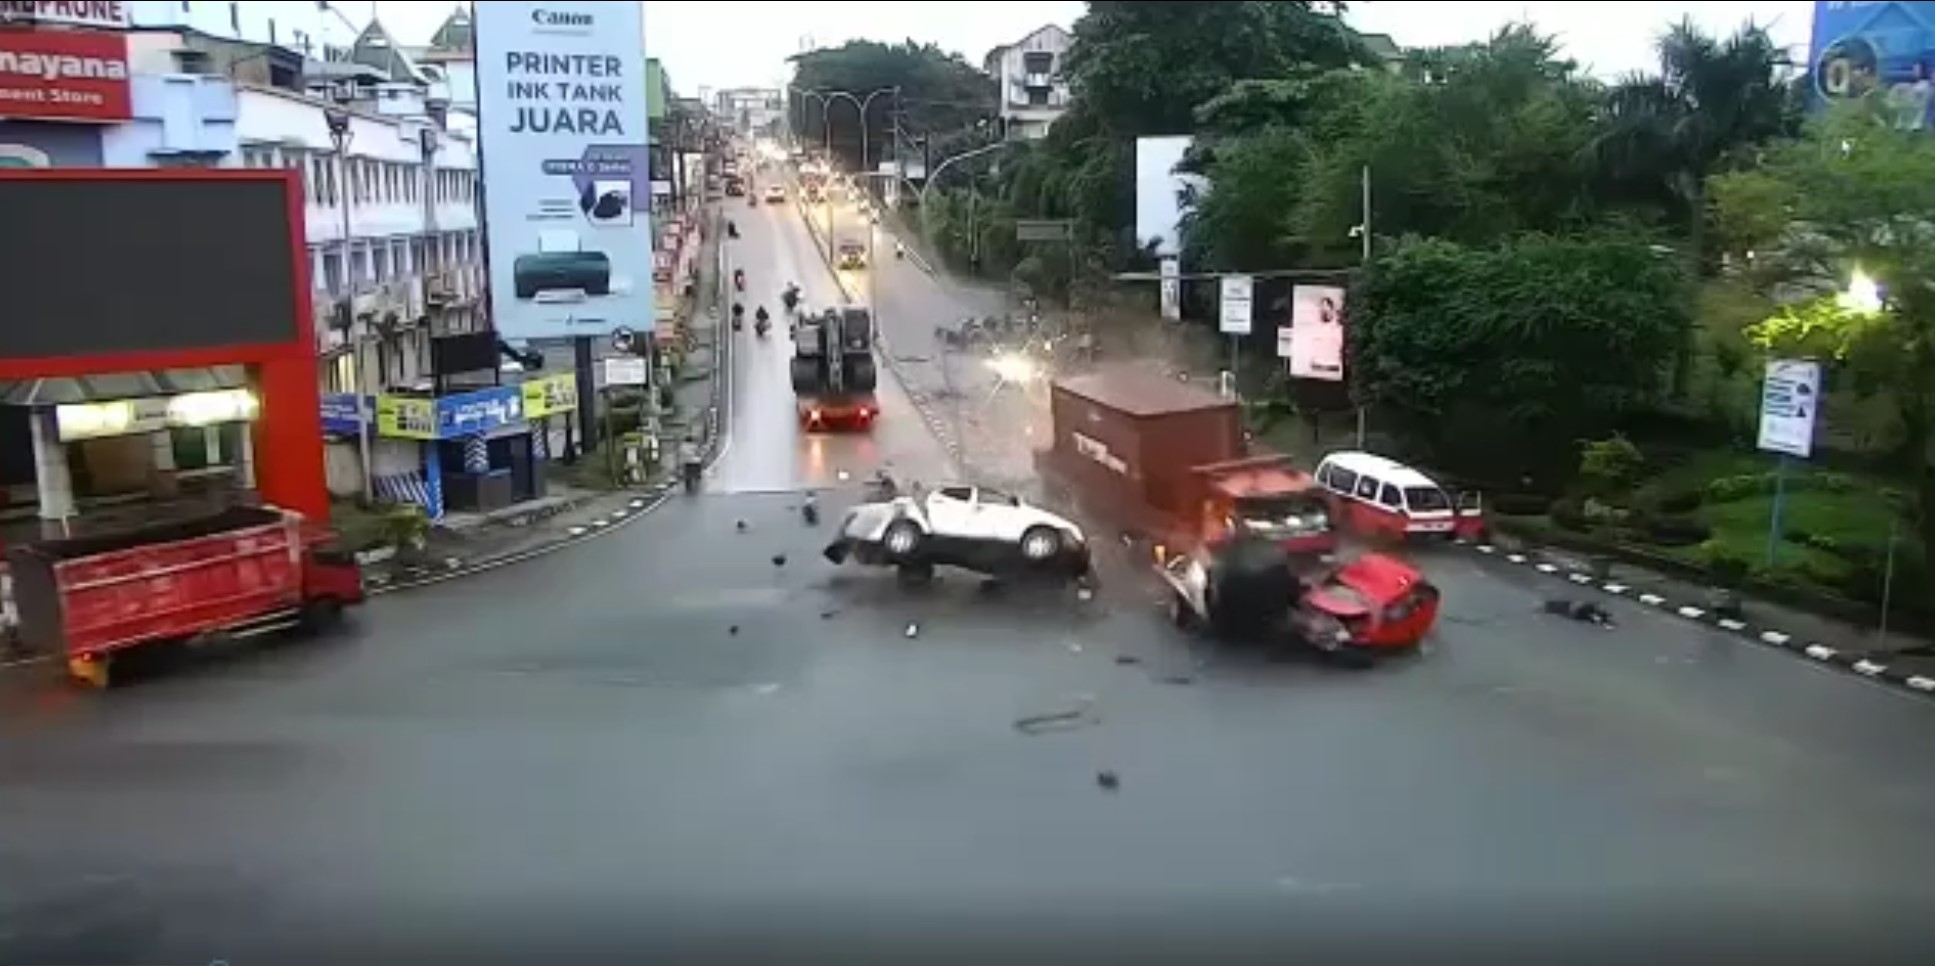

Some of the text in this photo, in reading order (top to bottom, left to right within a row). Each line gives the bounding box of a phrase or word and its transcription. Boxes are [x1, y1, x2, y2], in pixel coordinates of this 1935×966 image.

[531, 8, 594, 25] Canon
[506, 51, 623, 77] PRINTER
[49, 88, 104, 106] Store
[507, 81, 623, 102] INK TANK
[509, 106, 625, 136] JUARA
